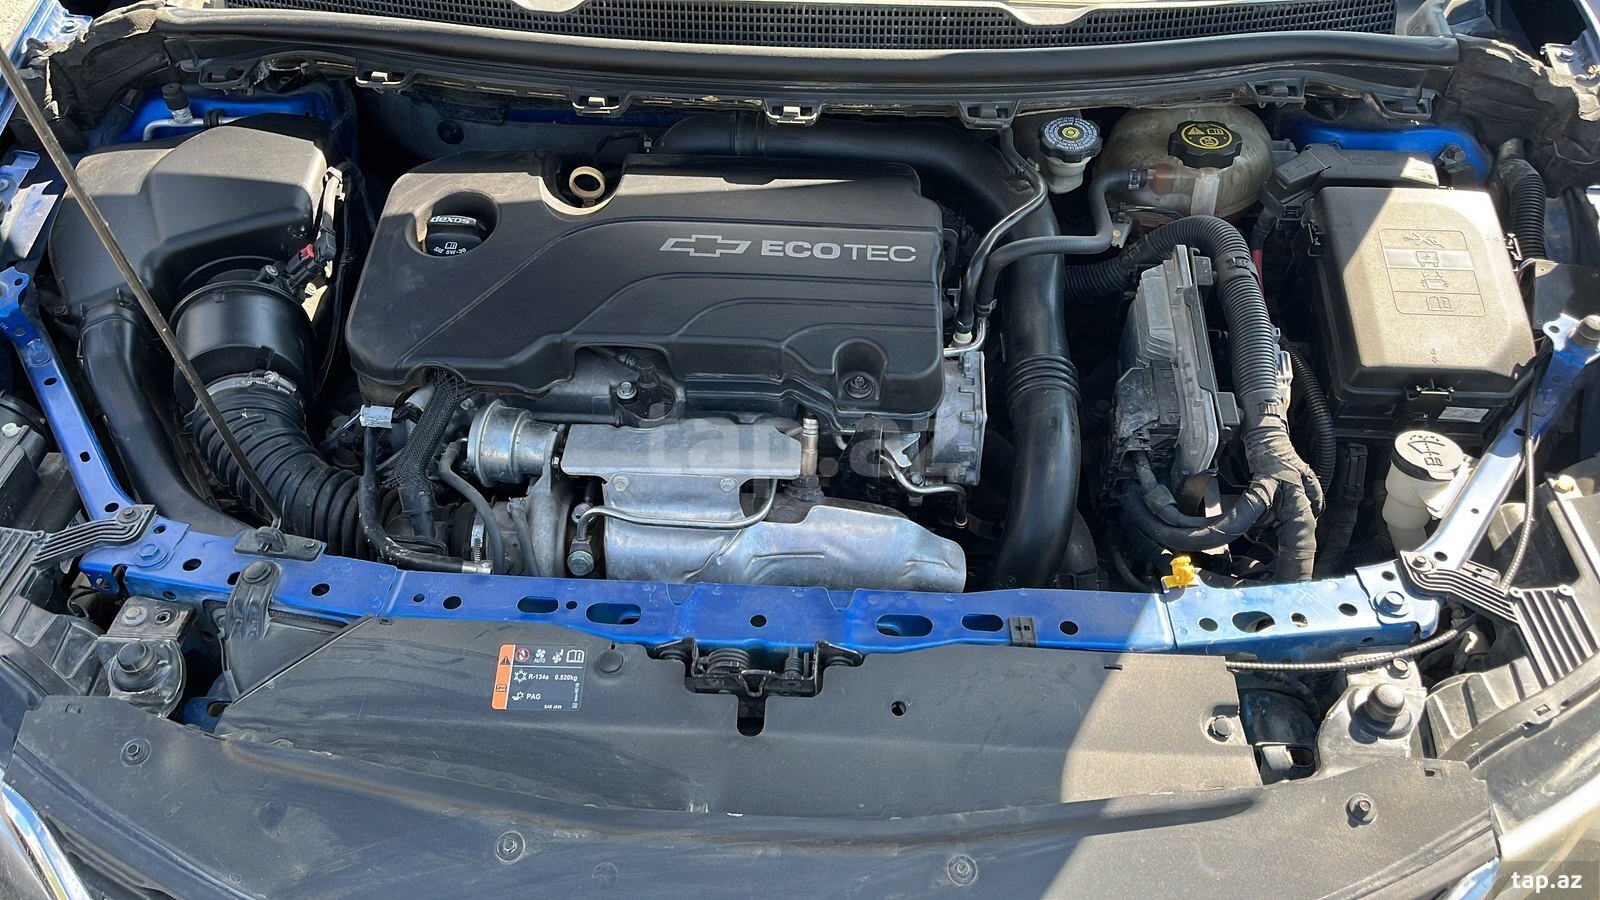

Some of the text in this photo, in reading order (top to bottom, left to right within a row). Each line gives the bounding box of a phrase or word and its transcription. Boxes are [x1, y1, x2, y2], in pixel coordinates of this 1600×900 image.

[430, 216, 470, 224] dexos
[445, 247, 467, 255] 5W-30
[760, 239, 917, 262] ECOTEC
[528, 673, 578, 682] R-134a 0.520kg
